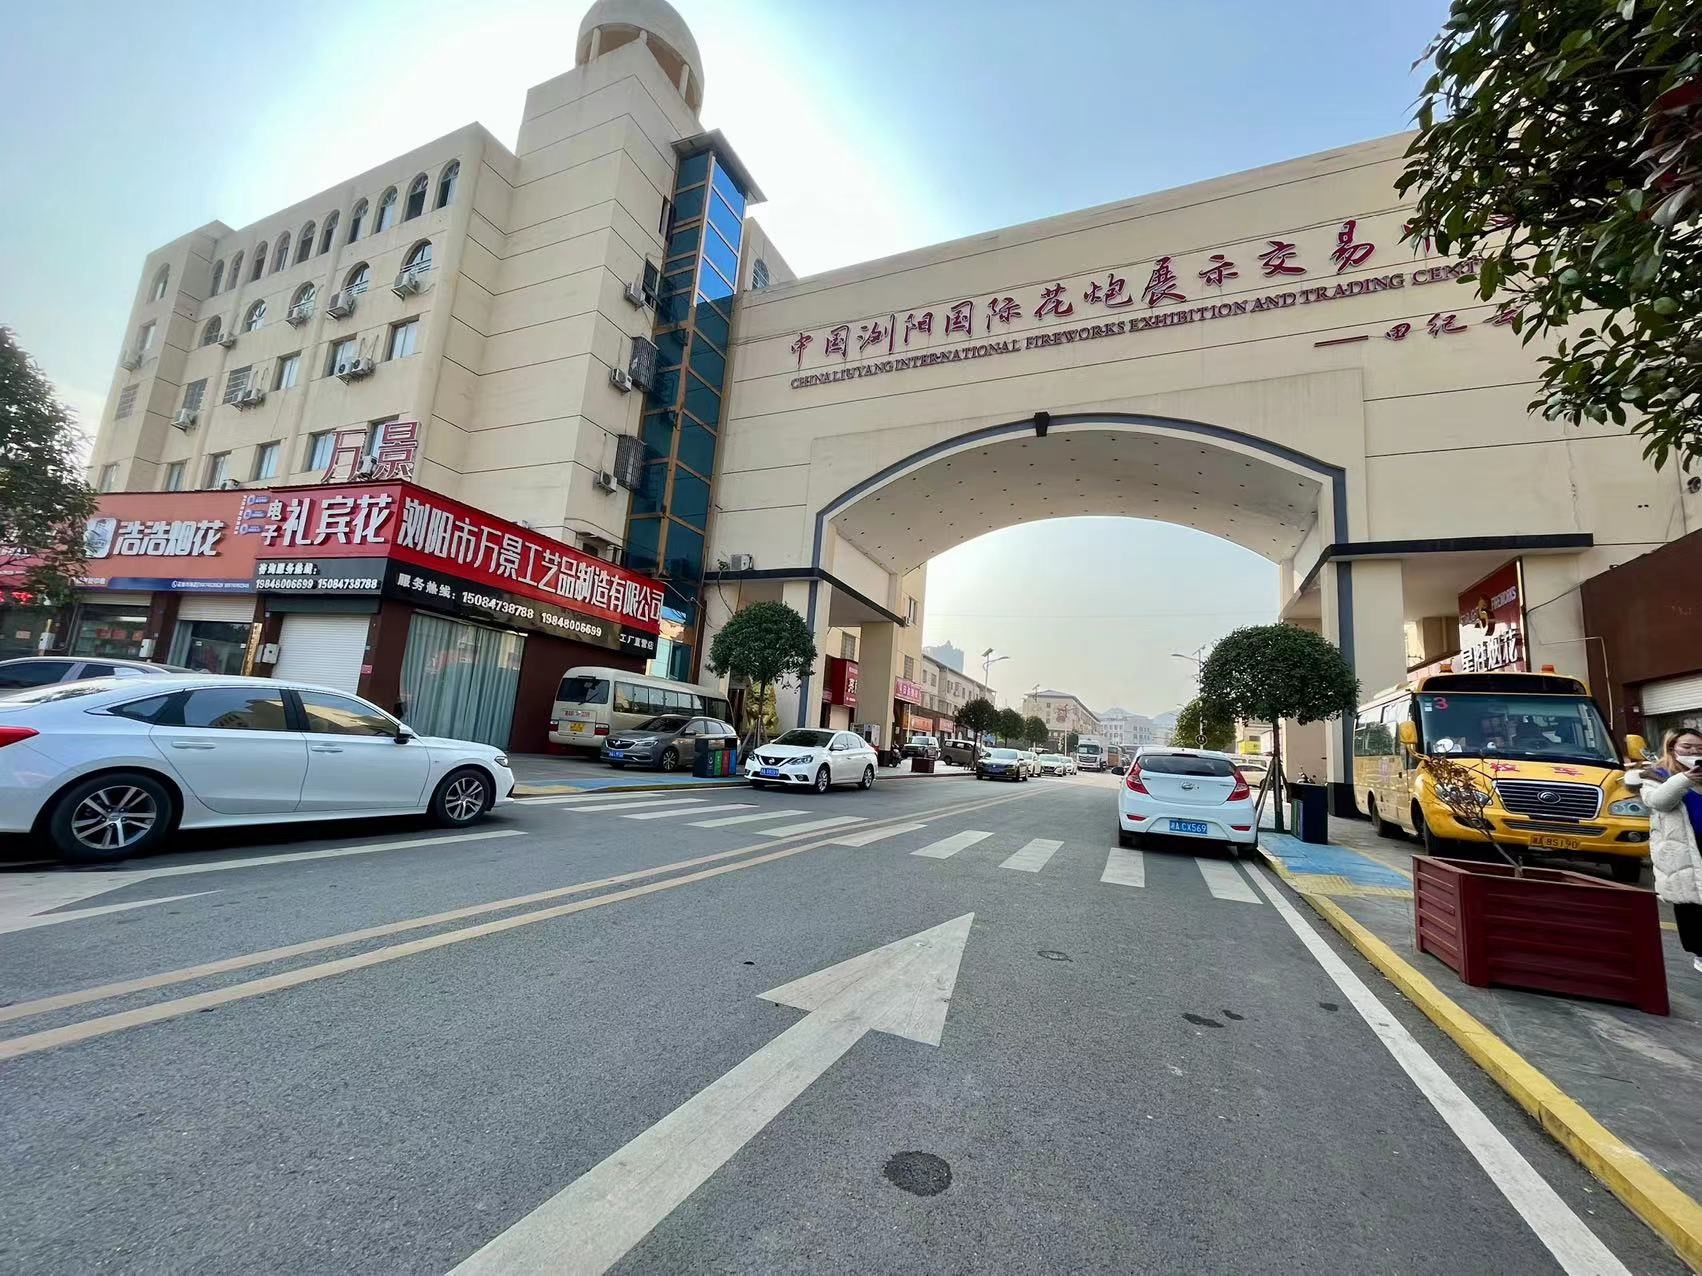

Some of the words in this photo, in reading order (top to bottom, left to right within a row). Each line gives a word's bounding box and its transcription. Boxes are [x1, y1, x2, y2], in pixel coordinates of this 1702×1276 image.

[791, 373, 831, 389] CHINA
[895, 340, 1021, 372] INTERNATIONAL
[1025, 320, 1126, 350] FIREWORKS
[1129, 299, 1249, 332] EXHIBITION
[1250, 291, 1297, 312] AND
[1299, 272, 1405, 305] TRADING
[321, 421, 418, 482] 万景
[113, 520, 226, 557] 浩浩烟花
[397, 497, 665, 623] 浏阳市万景工艺品制造有限公司
[256, 579, 314, 590] 19848006699
[317, 578, 378, 590] 15084738788
[462, 590, 534, 620] 15084738788
[541, 612, 602, 638] 19848006699
[619, 633, 655, 651] 工厂直营店
[1433, 697, 1449, 711] 3
